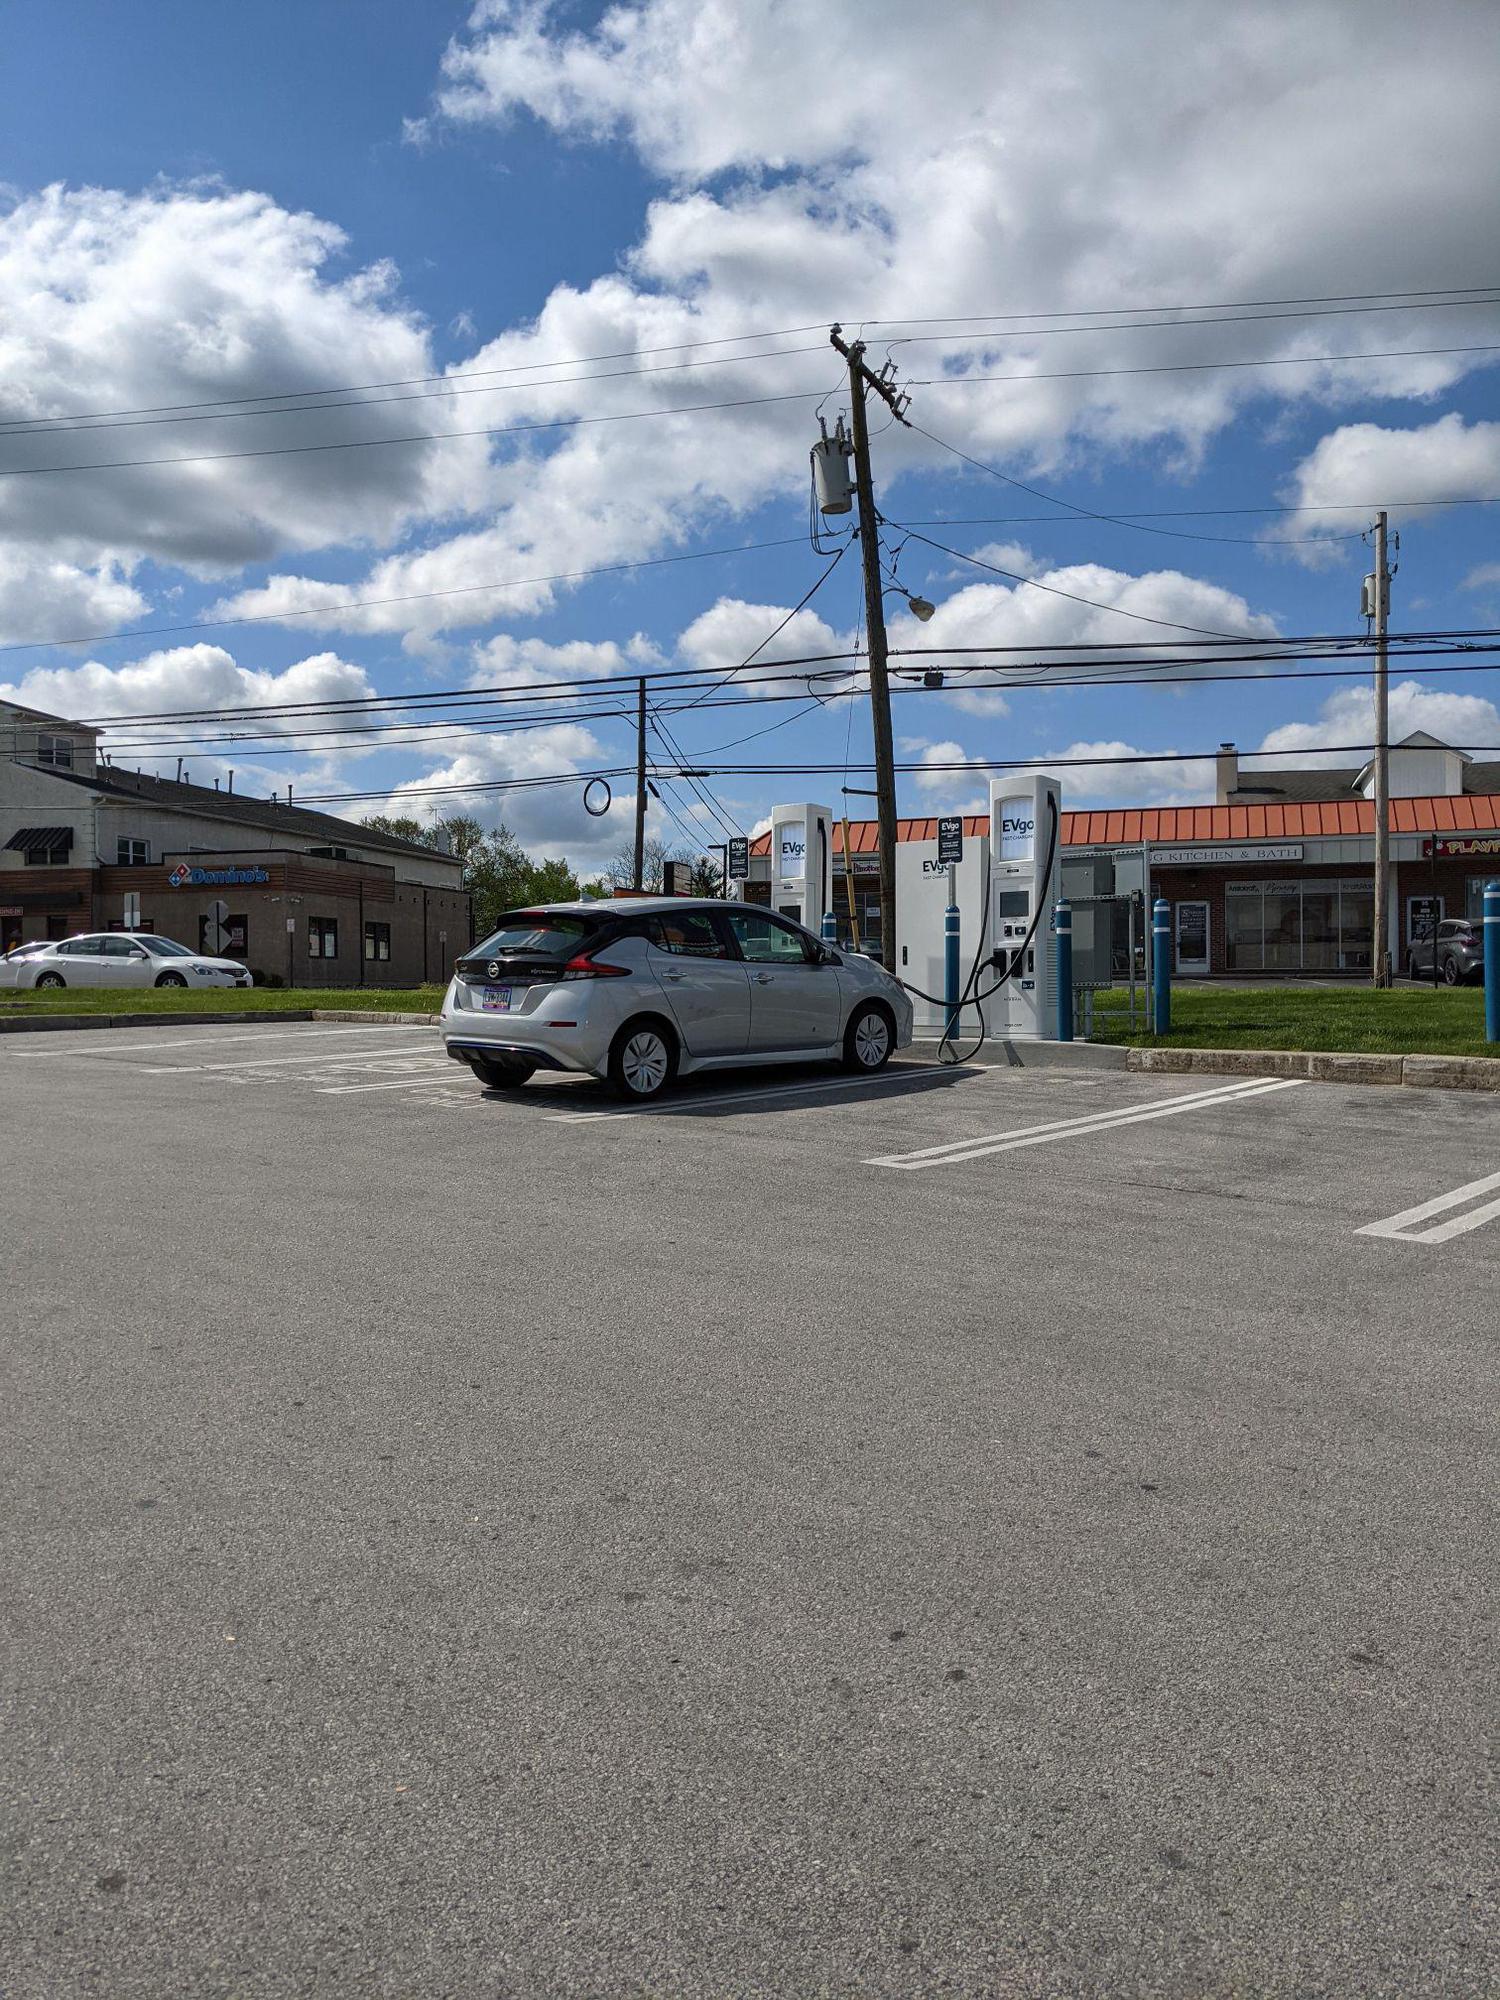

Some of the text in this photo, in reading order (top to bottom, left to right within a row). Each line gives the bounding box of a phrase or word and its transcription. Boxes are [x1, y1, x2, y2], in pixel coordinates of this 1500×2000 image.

[941, 822, 960, 831] EVgo
[1002, 818, 1035, 834] EVgo
[731, 842, 746, 850] EVgo
[1169, 851, 1233, 862] KITCHEN
[1240, 849, 1250, 859] &
[1257, 848, 1298, 858] BATH
[191, 865, 267, 884] Domino's
